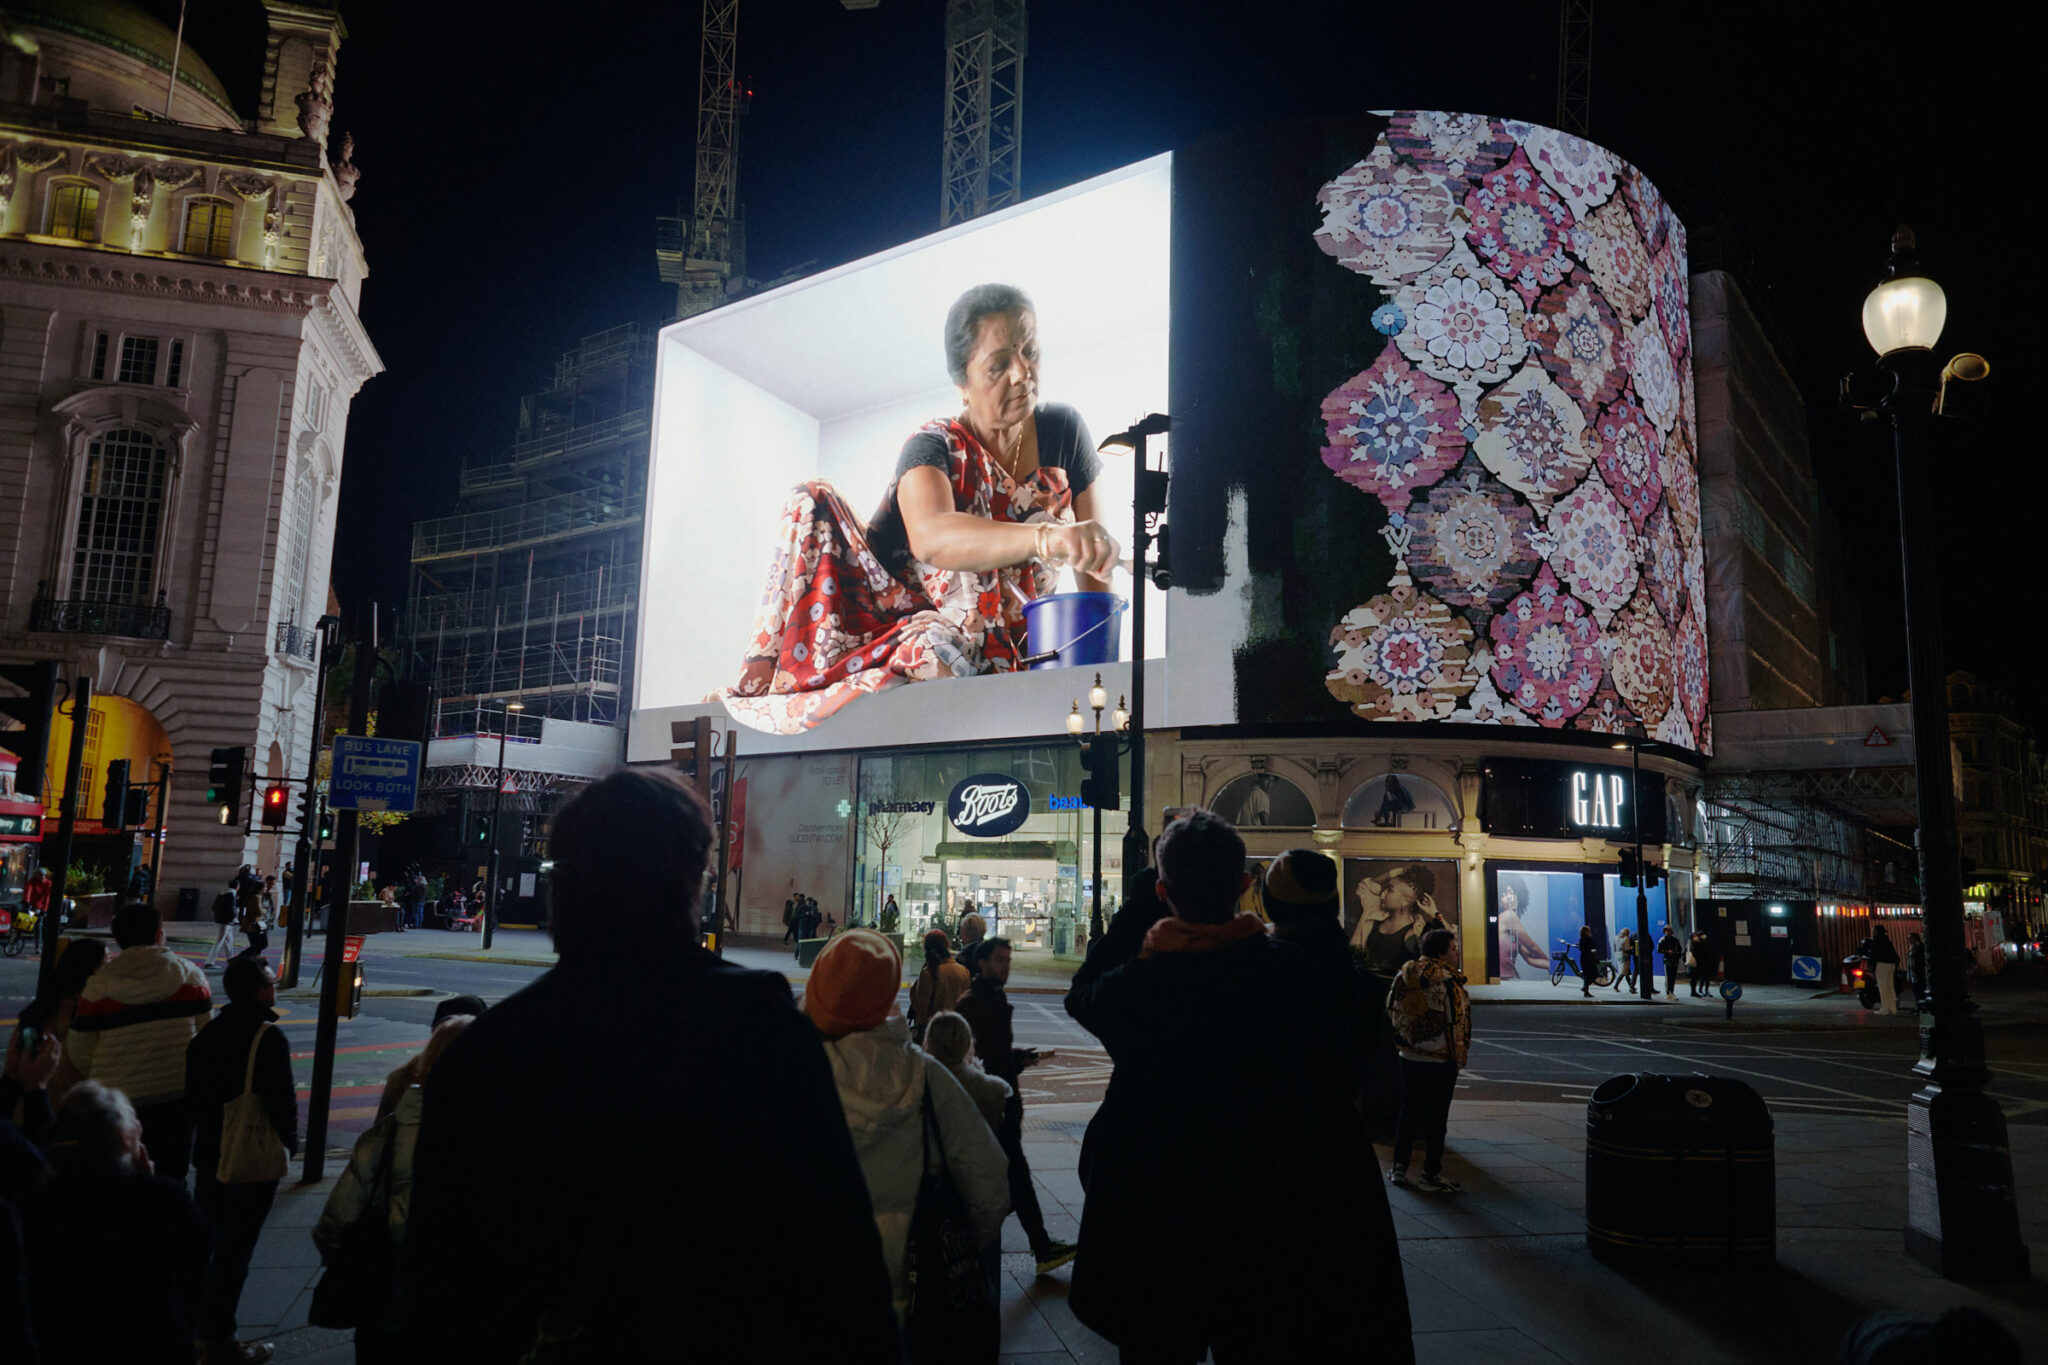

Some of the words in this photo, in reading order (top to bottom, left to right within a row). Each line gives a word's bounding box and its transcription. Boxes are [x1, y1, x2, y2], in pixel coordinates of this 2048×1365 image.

[344, 741, 373, 752] BUS
[376, 743, 411, 756] LANE
[335, 778, 372, 791] LOOK
[376, 781, 412, 793] BOTH
[832, 776, 845, 785] LET
[953, 782, 1019, 826] Boots
[1572, 771, 1625, 828] GAP
[868, 799, 936, 817] pharmacy
